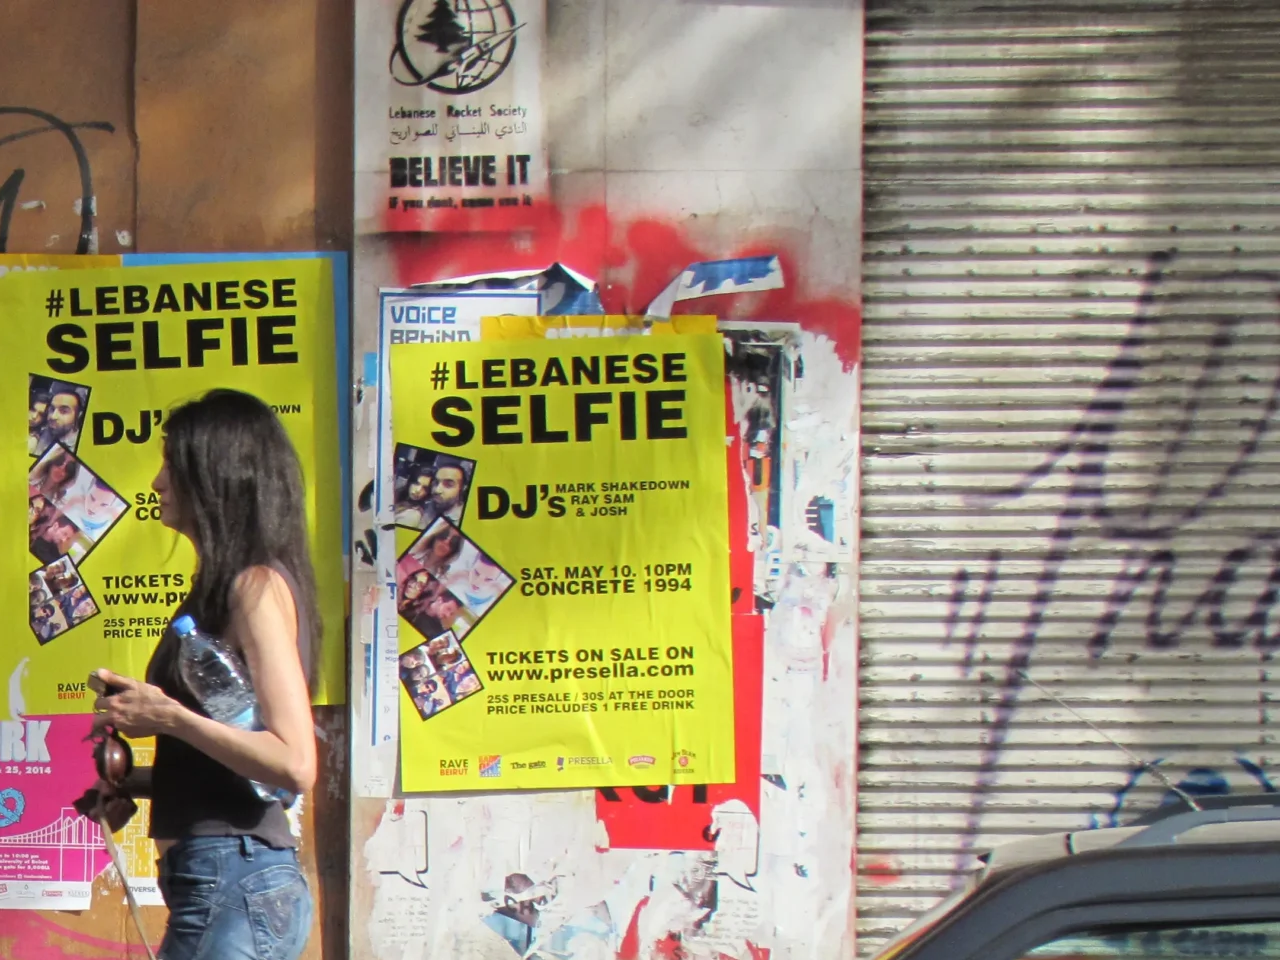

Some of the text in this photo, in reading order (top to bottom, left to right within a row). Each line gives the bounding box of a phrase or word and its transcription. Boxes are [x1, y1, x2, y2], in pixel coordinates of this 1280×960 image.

[389, 104, 527, 118] Lebanese Rocket Society
[389, 154, 531, 188] BELIEVE IT
[46, 279, 296, 317] #LEBANESE
[47, 315, 298, 374] SELFIE
[431, 353, 686, 389] #LEBANESE
[432, 390, 687, 447] SELFIE
[92, 410, 162, 445] DJ'
[556, 481, 689, 493] MARK SHAKEDOWN
[478, 484, 566, 520] DJ's
[571, 494, 634, 505] RAY SAM
[576, 506, 627, 517] & JOSH
[521, 564, 691, 580] SAT. MAY 10. 10PM
[102, 574, 184, 589] TICKETS
[520, 578, 691, 596] CONCRETE 1994
[129, 616, 170, 627] PRESA
[104, 628, 142, 638] PRICE
[486, 647, 693, 664] TICKETS ON SALE ON
[488, 665, 693, 682] www.presella.com
[57, 683, 86, 692] RAVE
[57, 692, 86, 700] BEIRUT
[487, 695, 509, 703] 25$
[514, 693, 570, 702] PRESALE
[583, 692, 604, 700] 30$
[609, 691, 623, 699] AT
[628, 691, 653, 699] THE
[658, 690, 694, 698] DOOR
[488, 705, 526, 714] PRICE
[531, 703, 597, 713] INCLUDES
[615, 702, 647, 711] FREE
[652, 701, 693, 710] DRINK
[440, 759, 468, 768] RAVE
[568, 756, 612, 765] PRESELLA
[6, 766, 21, 775] 25,
[440, 768, 468, 776] BEIRUT
